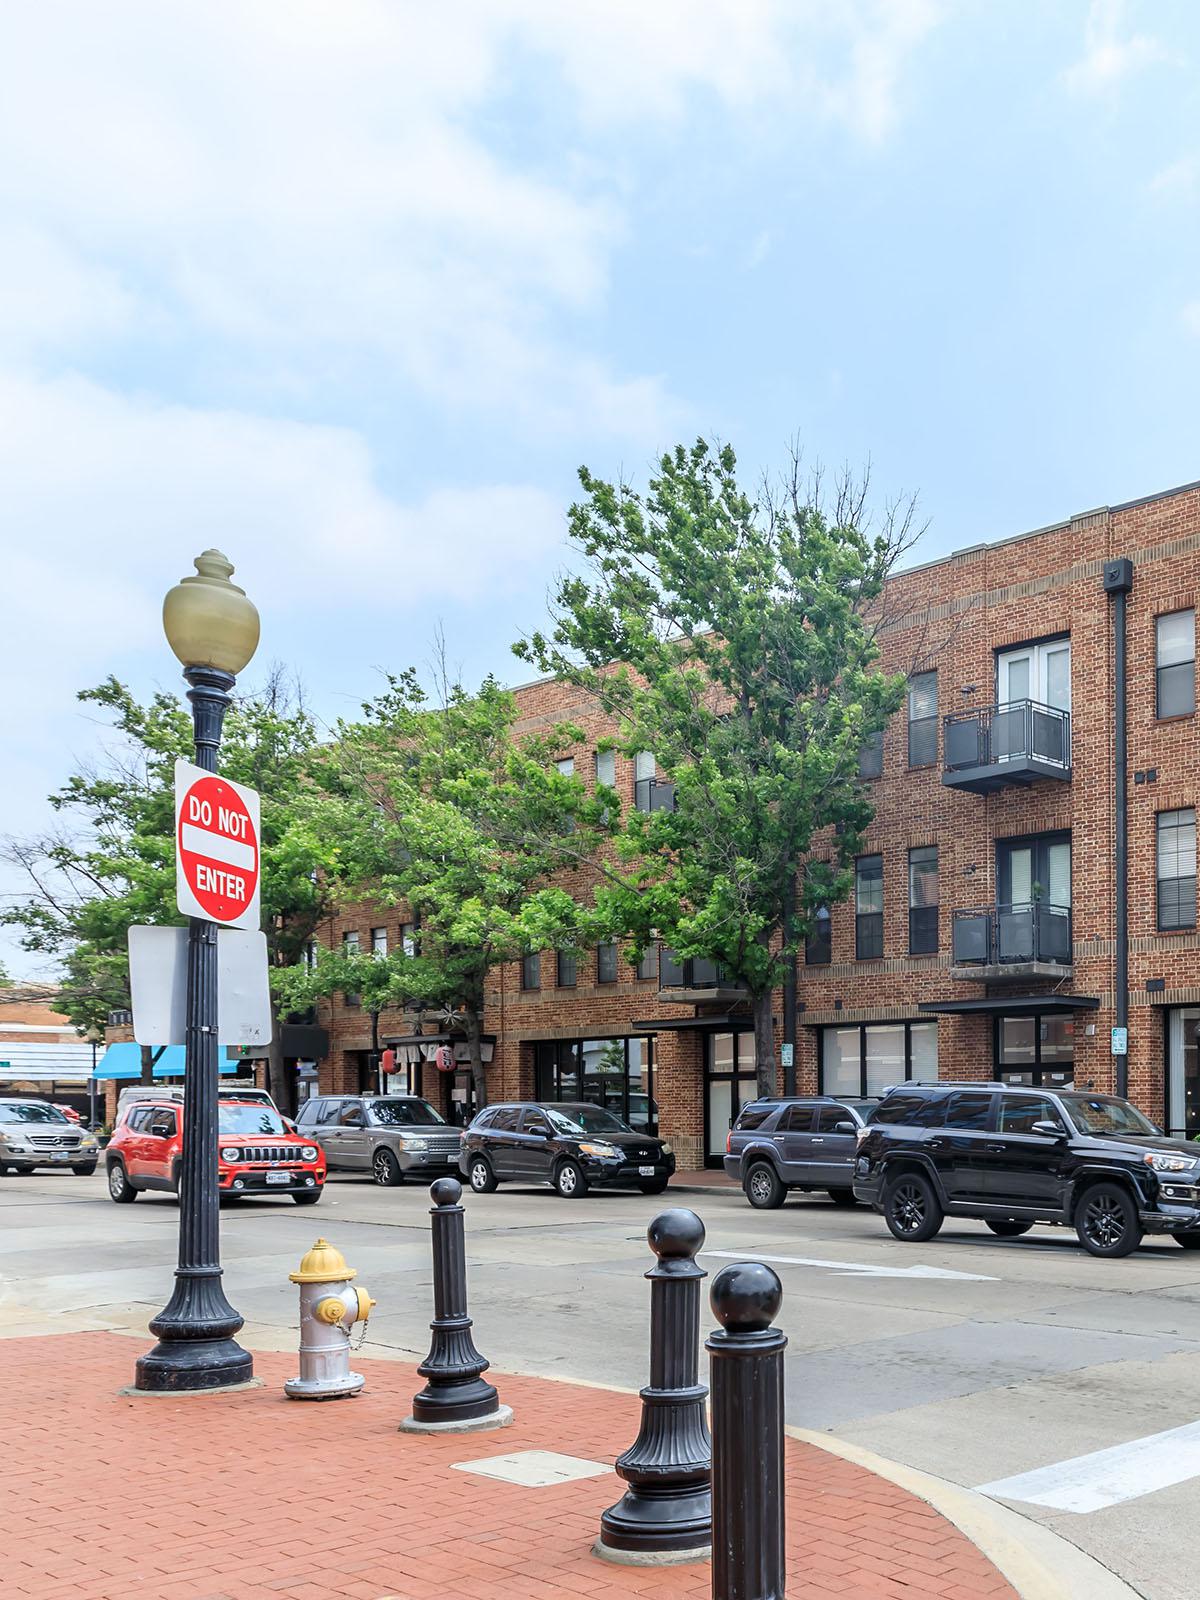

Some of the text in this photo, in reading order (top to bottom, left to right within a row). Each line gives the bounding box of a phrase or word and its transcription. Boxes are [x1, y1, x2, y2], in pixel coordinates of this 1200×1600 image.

[189, 795, 248, 839] DO NOT
[196, 864, 245, 902] ENTER
